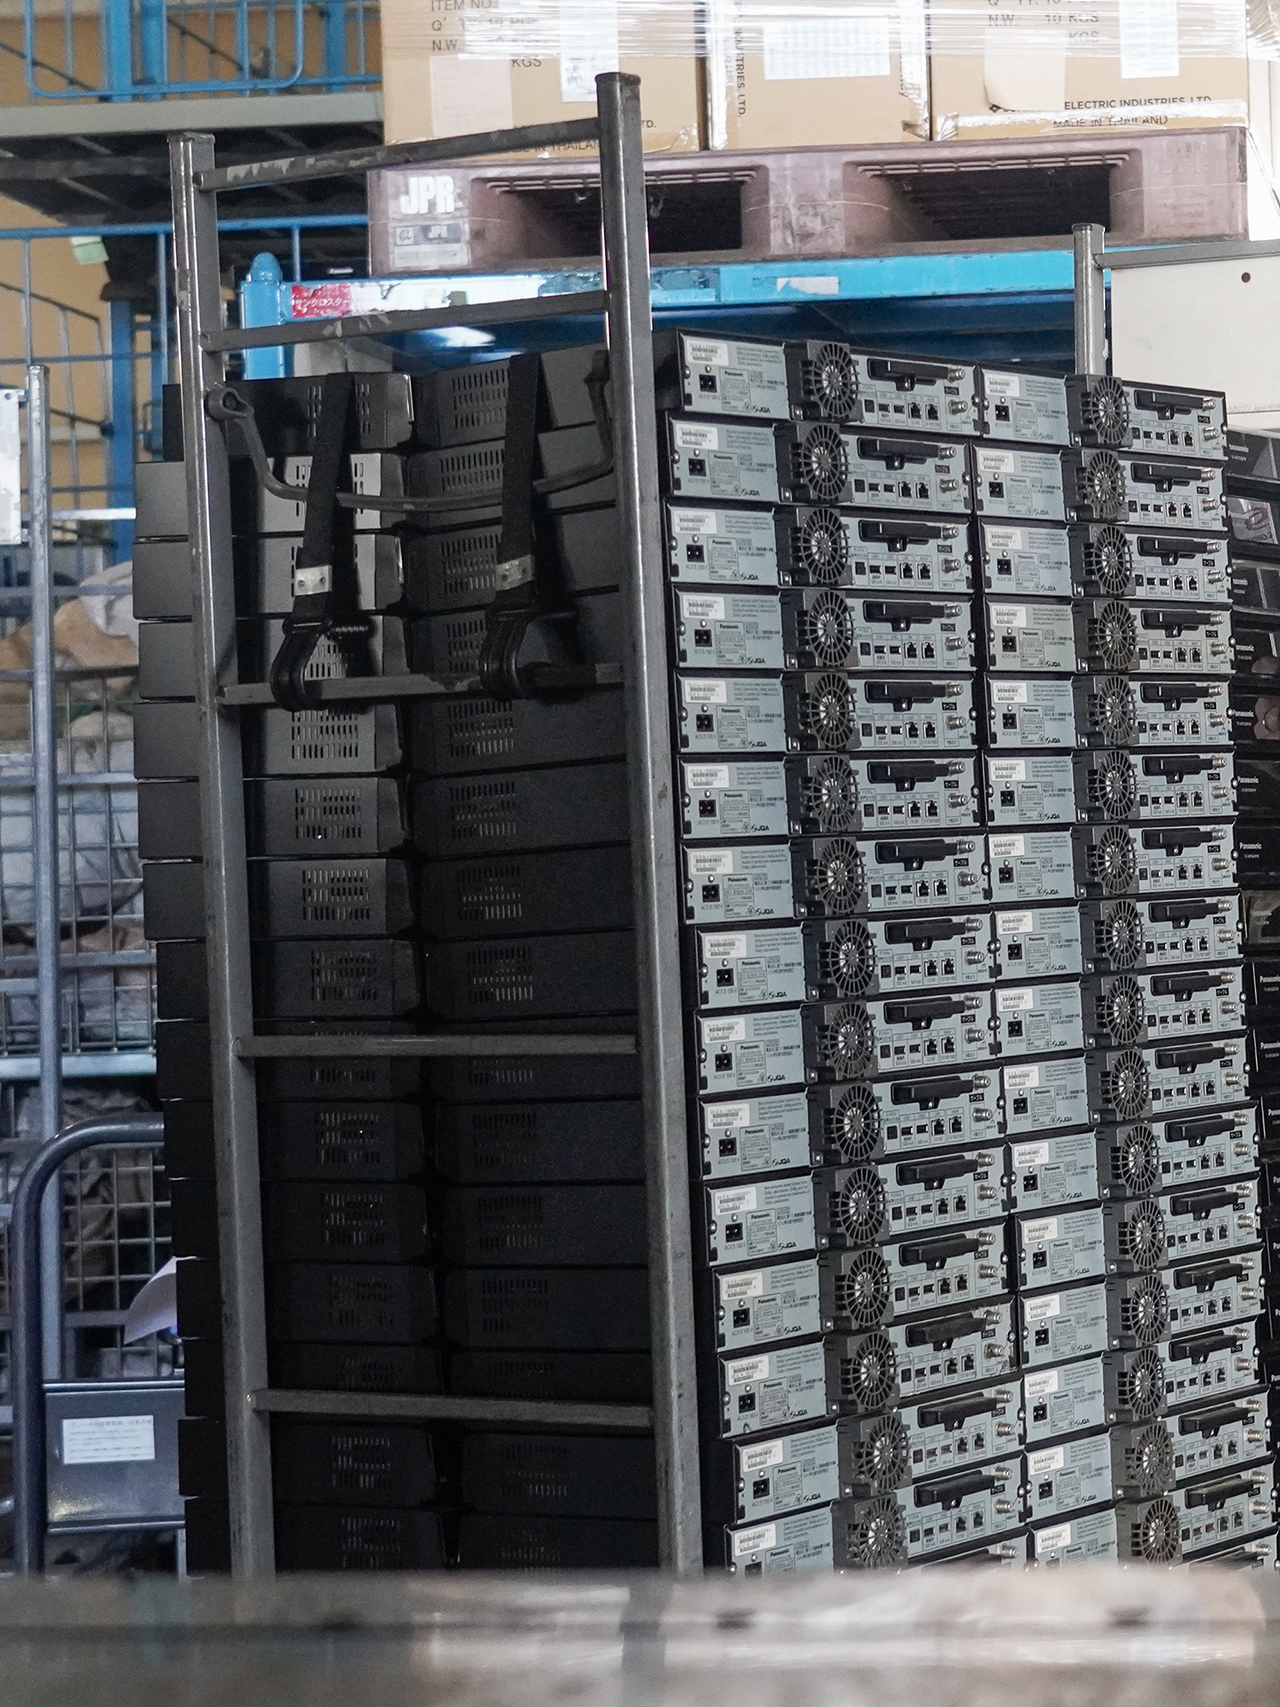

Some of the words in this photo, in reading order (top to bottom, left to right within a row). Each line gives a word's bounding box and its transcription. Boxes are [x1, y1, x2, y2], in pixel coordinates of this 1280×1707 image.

[1064, 100, 1116, 110] ELECTRIC
[400, 176, 456, 215] JPR
[1238, 776, 1259, 784] Panasonic
